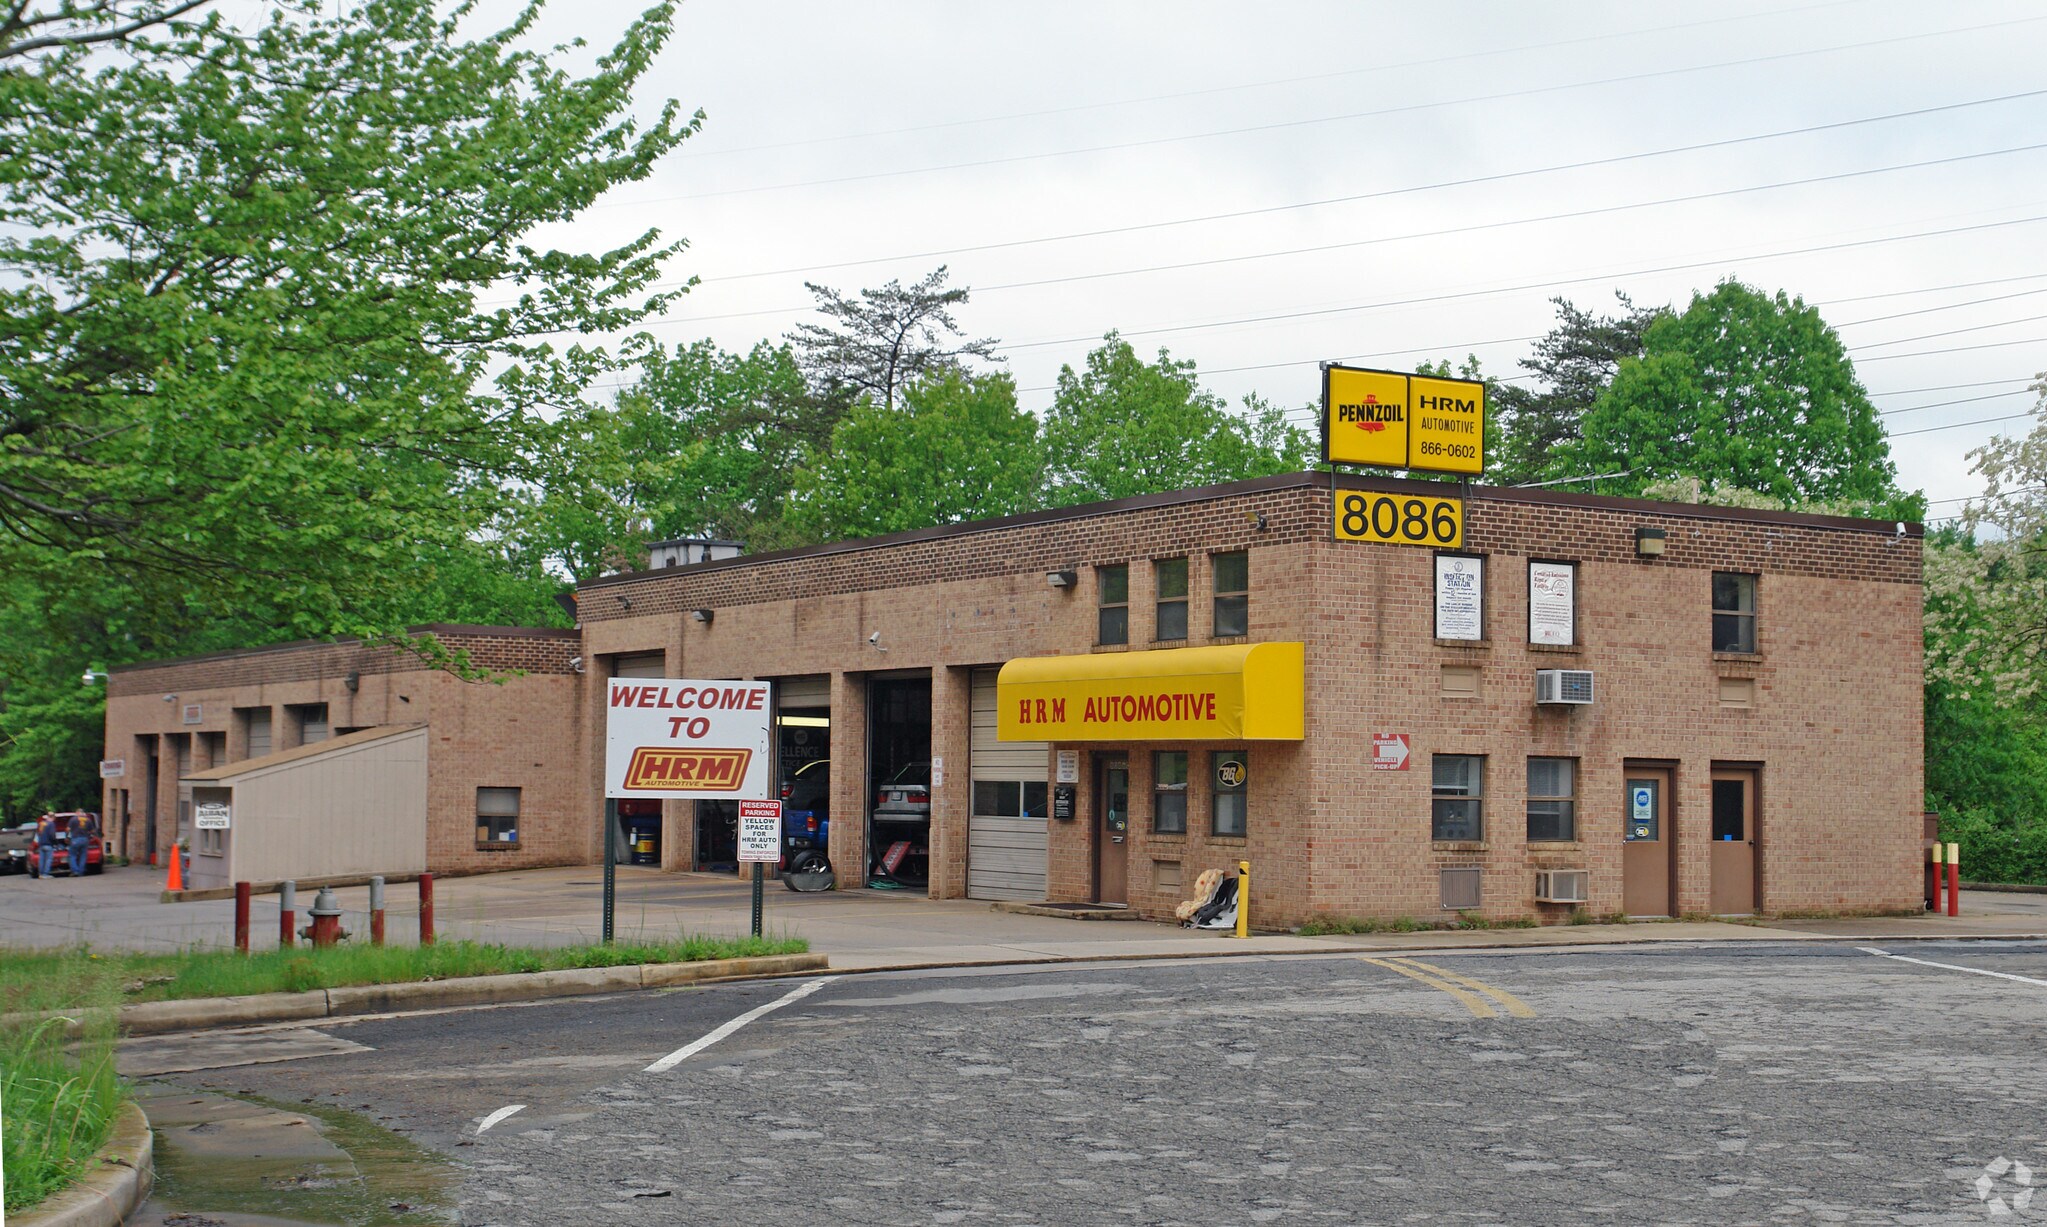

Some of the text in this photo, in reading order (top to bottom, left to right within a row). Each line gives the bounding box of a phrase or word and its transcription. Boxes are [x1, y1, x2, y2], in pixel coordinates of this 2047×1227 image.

[1339, 404, 1404, 423] PENNZOIL
[1420, 395, 1475, 414] HRM
[1421, 417, 1475, 434] AUTOMOTIVE
[1421, 442, 1475, 459] 866-0602
[1342, 494, 1457, 543] 8086
[611, 686, 767, 710] WELCOME
[1019, 693, 1216, 724] HRM AUTOMOTIVE
[667, 716, 710, 739] TO
[641, 757, 735, 780] HRM
